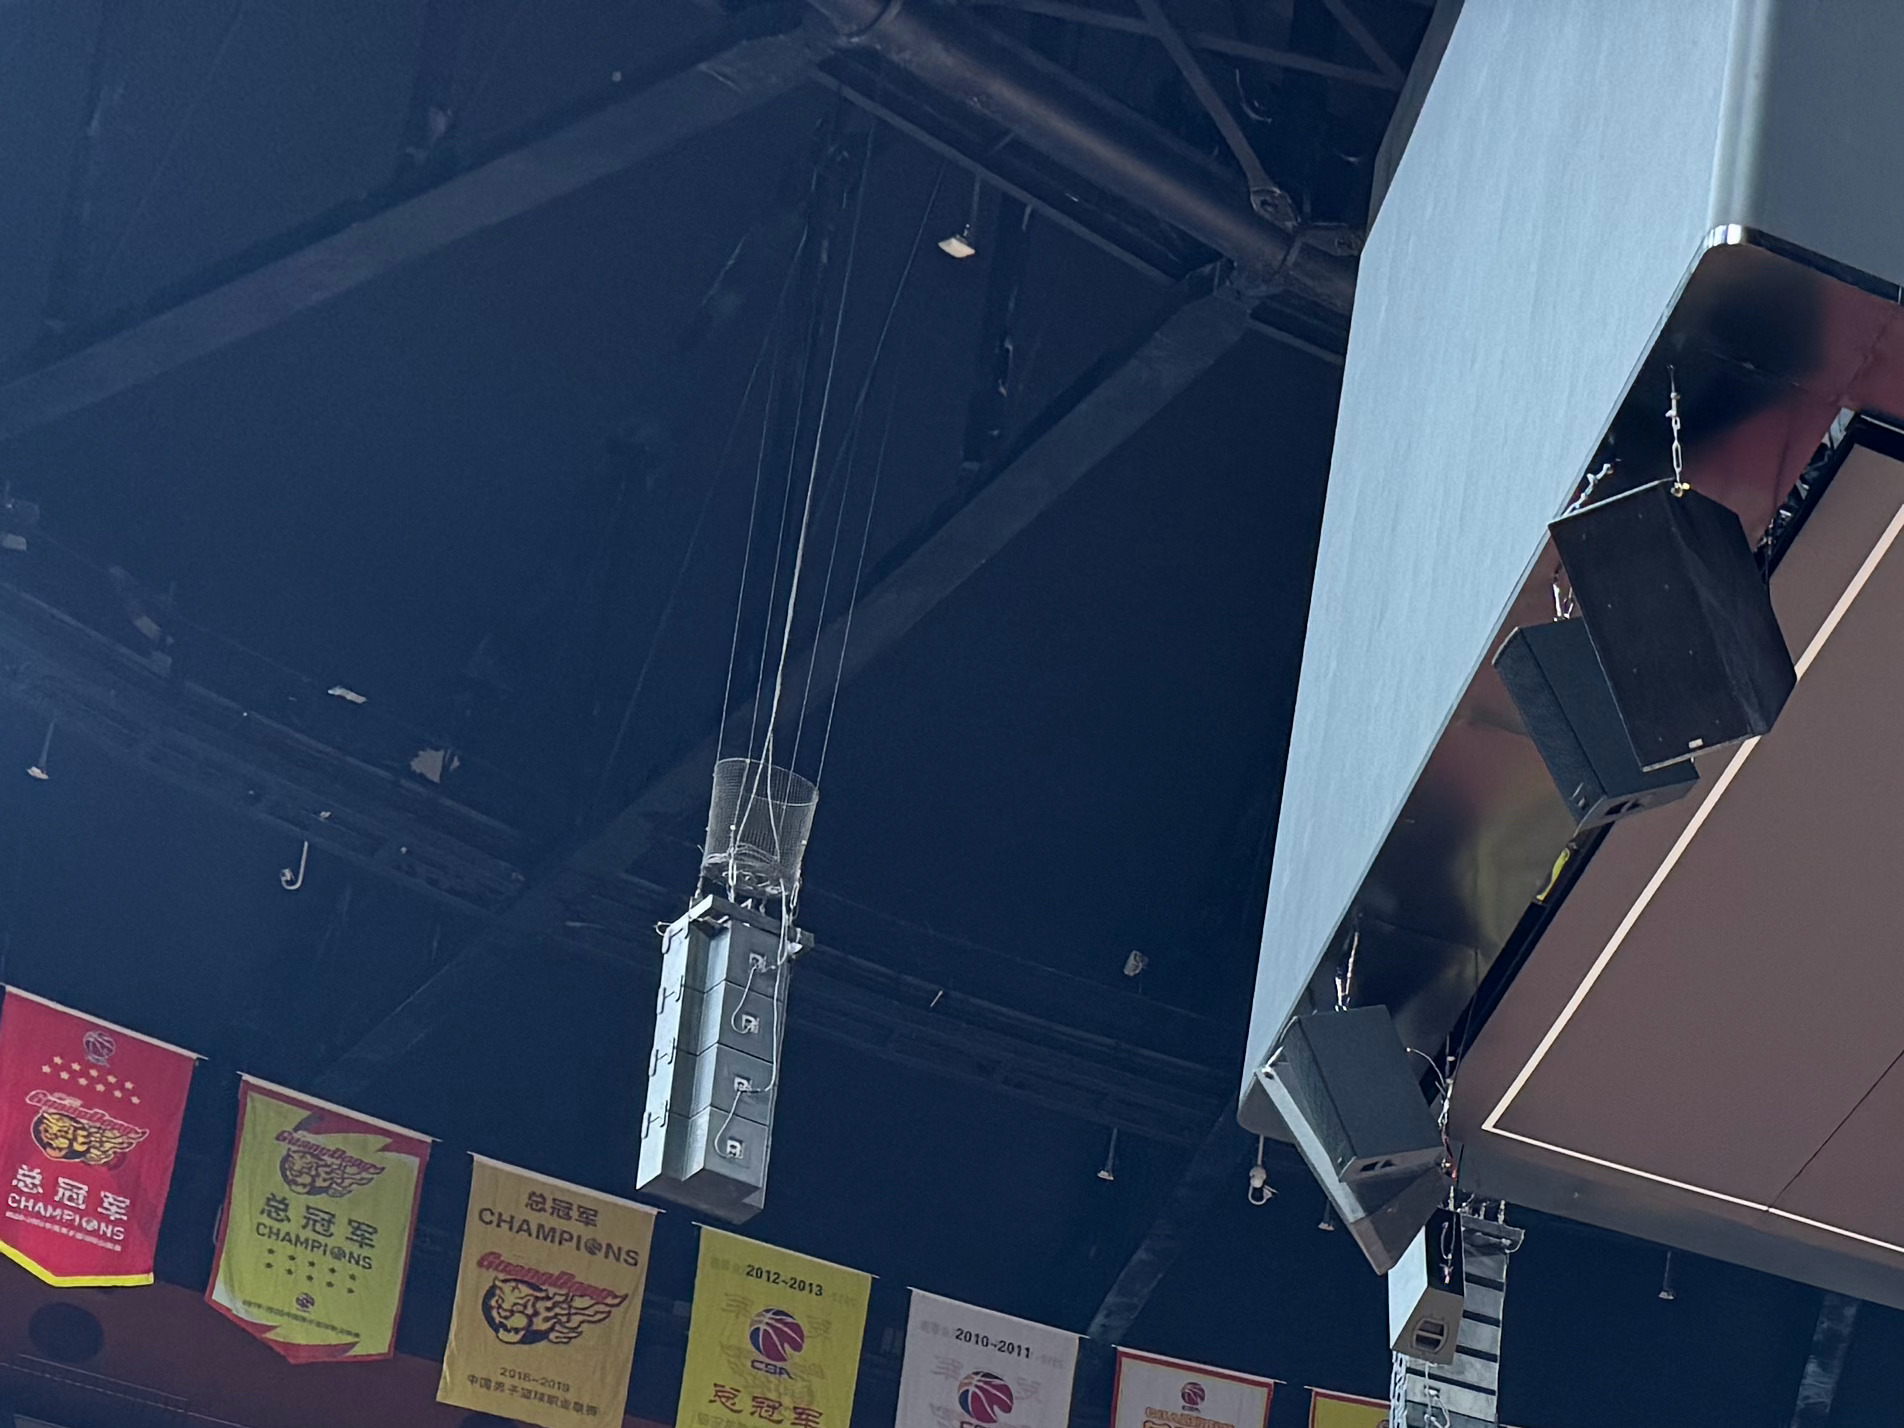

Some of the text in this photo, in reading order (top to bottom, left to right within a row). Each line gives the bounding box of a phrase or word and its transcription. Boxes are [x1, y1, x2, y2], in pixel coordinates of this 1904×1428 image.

[11, 1164, 130, 1221] 总冠军
[259, 1192, 378, 1249] 总冠军
[525, 1190, 599, 1228] 总冠军
[255, 1221, 373, 1270] CHAMPIONS
[478, 1207, 640, 1267] CHAMPIONS
